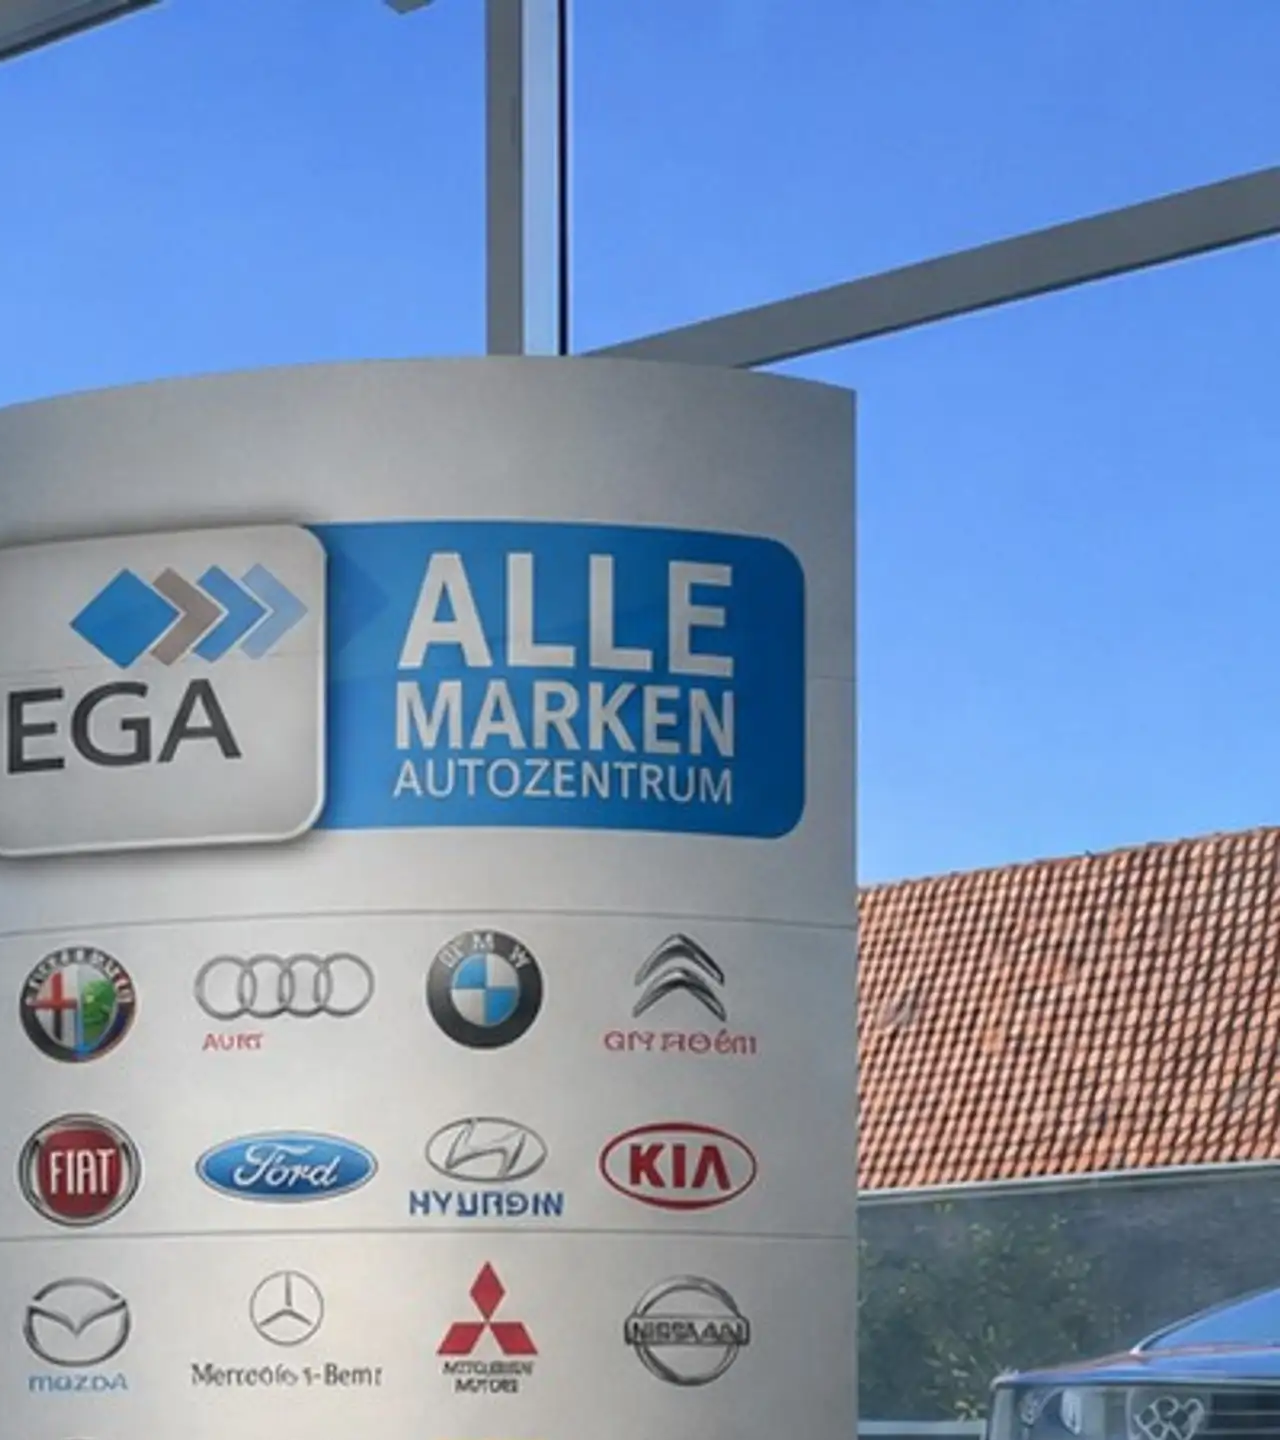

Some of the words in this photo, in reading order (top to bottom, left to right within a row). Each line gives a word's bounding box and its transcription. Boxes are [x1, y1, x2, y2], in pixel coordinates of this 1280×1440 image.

[398, 551, 735, 677] ALLE
[5, 677, 243, 776] EGA
[395, 680, 736, 758] MARKEN
[392, 758, 733, 805] AUTOZENTRUM
[48, 1148, 116, 1196] FIAT
[233, 1142, 341, 1188] Ford
[628, 1142, 732, 1191] KIA
